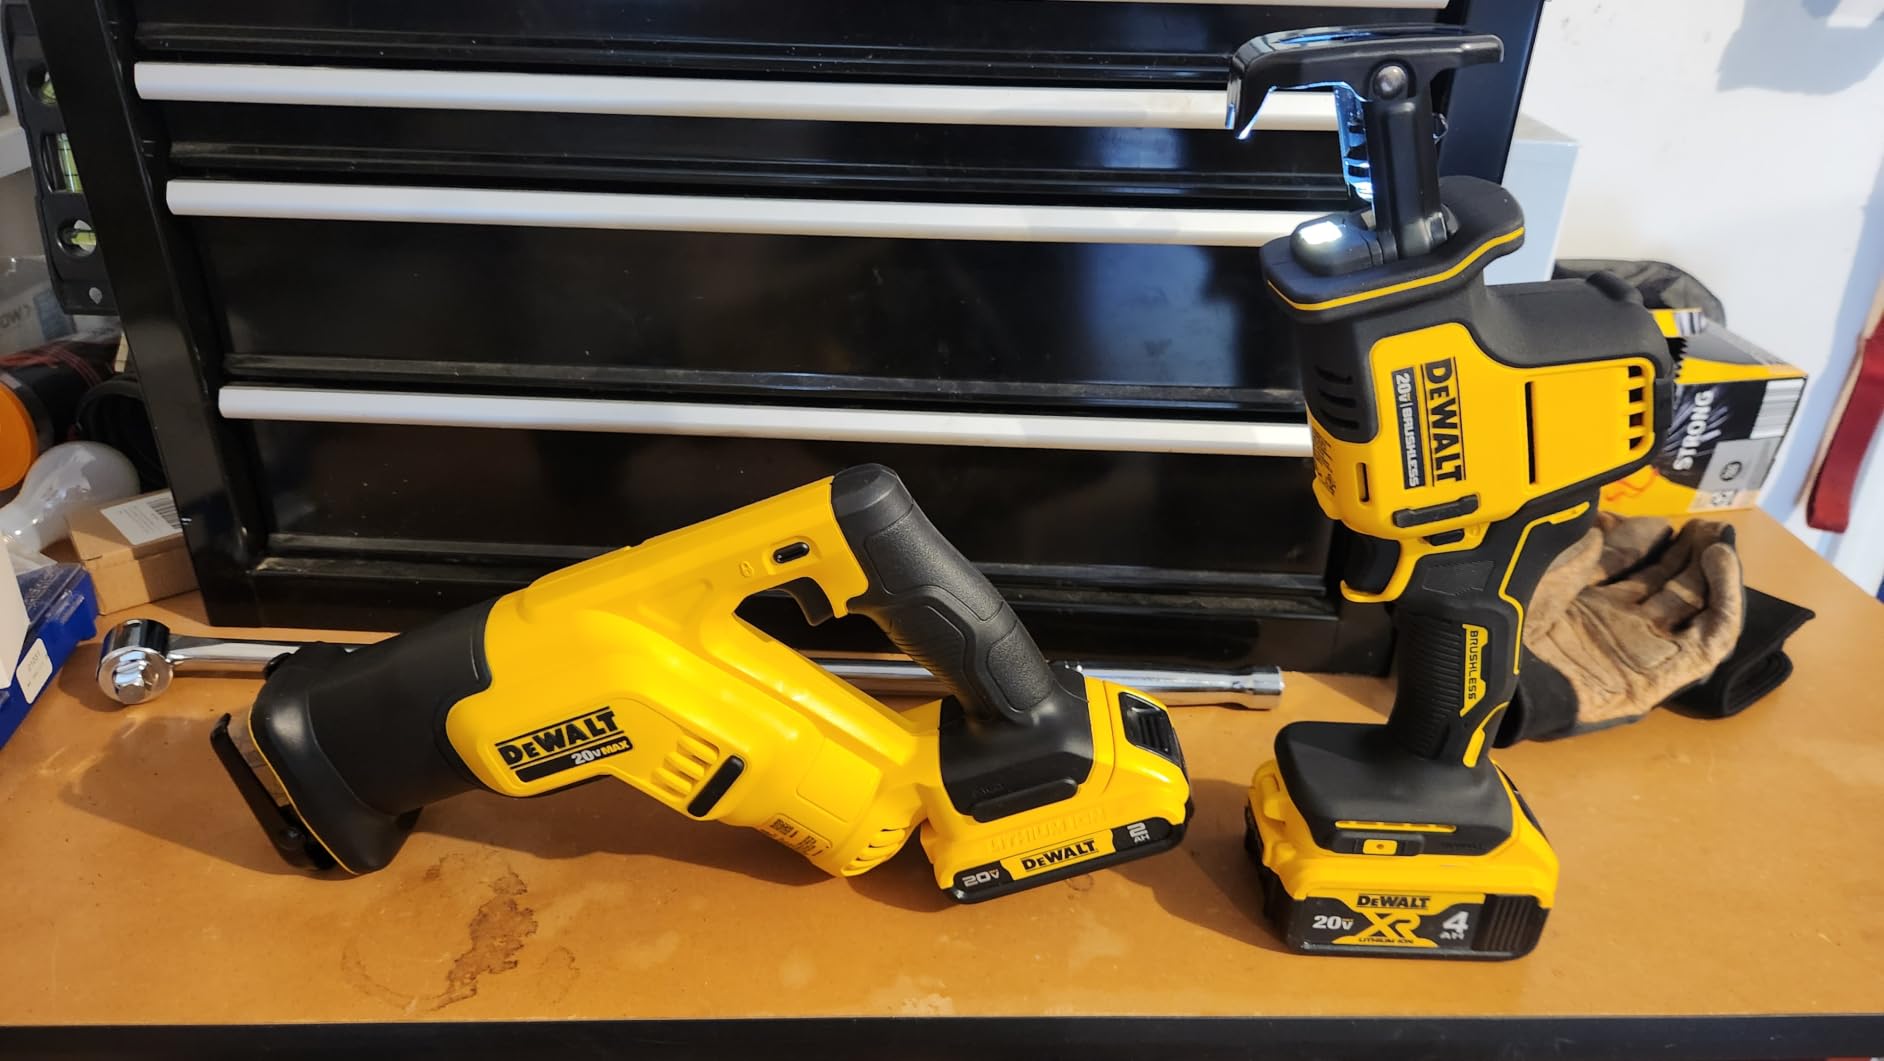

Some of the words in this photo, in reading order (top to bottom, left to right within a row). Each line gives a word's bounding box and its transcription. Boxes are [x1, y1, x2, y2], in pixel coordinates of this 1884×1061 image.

[1425, 358, 1462, 481] DEWALT
[1672, 390, 1714, 470] STRONG
[1402, 407, 1419, 487] BRUSHLESS
[1468, 630, 1478, 700] BRUSHLESS
[498, 710, 618, 766] DEWALT
[602, 740, 630, 756] MAX
[1127, 822, 1148, 838] 2
[1133, 834, 1150, 843] AH
[1021, 840, 1097, 871] DEWALT
[1357, 895, 1430, 908] DEWALT
[1355, 911, 1421, 938] XR
[1442, 911, 1469, 932] 4
